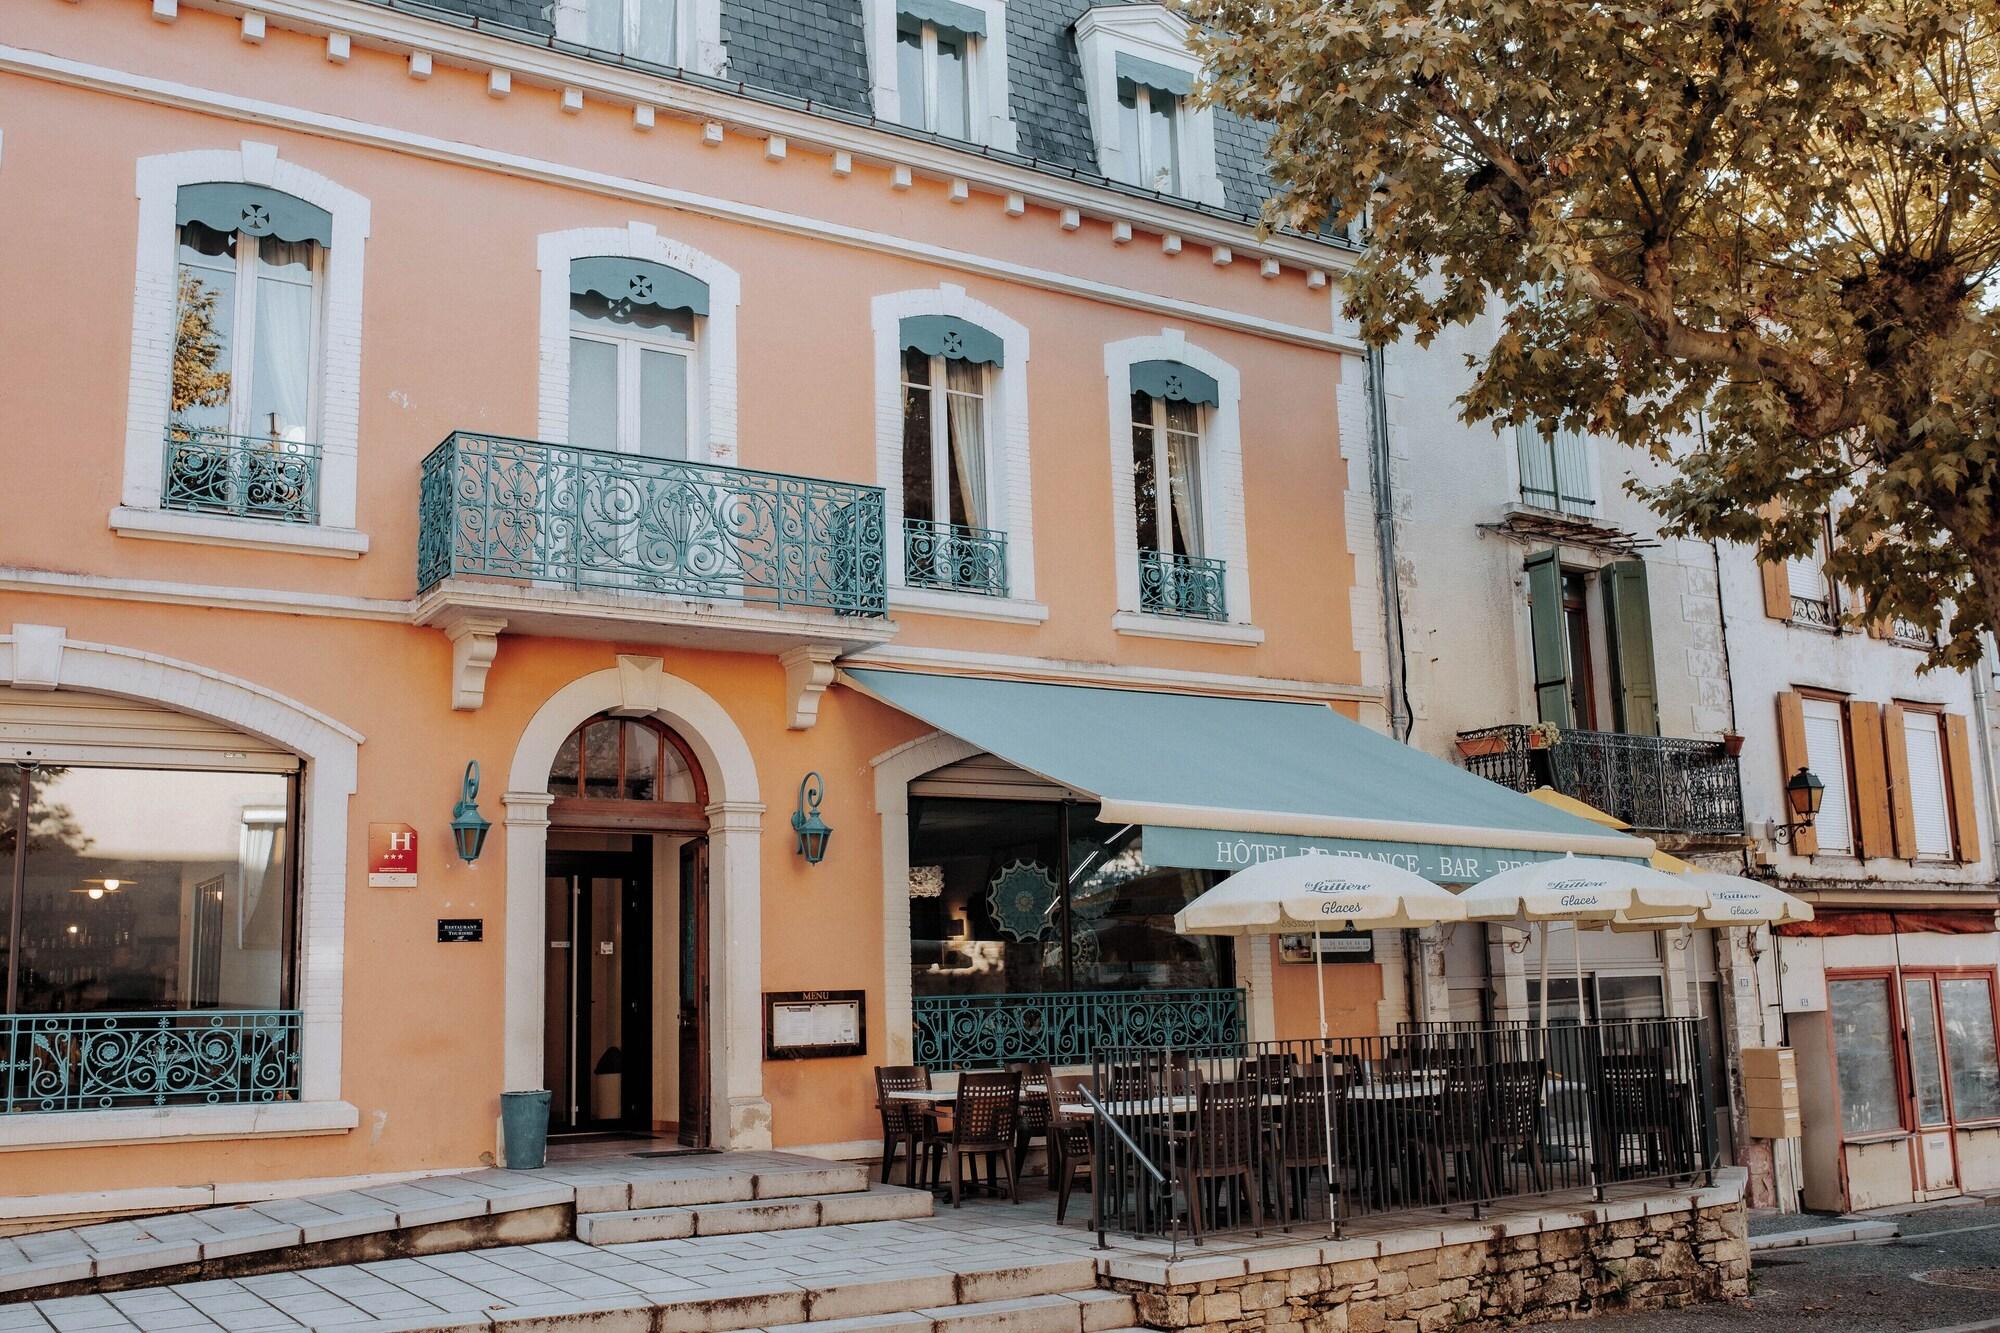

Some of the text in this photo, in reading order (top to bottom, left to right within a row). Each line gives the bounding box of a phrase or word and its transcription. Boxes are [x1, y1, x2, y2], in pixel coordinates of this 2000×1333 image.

[389, 832, 412, 851] H
[1337, 850, 1421, 874] NCE
[1439, 857, 1480, 878] BAR
[1561, 895, 1598, 906] Glaces
[1321, 901, 1362, 914] Glaces
[1730, 905, 1760, 915] Glaces
[802, 992, 829, 1000] MENU
